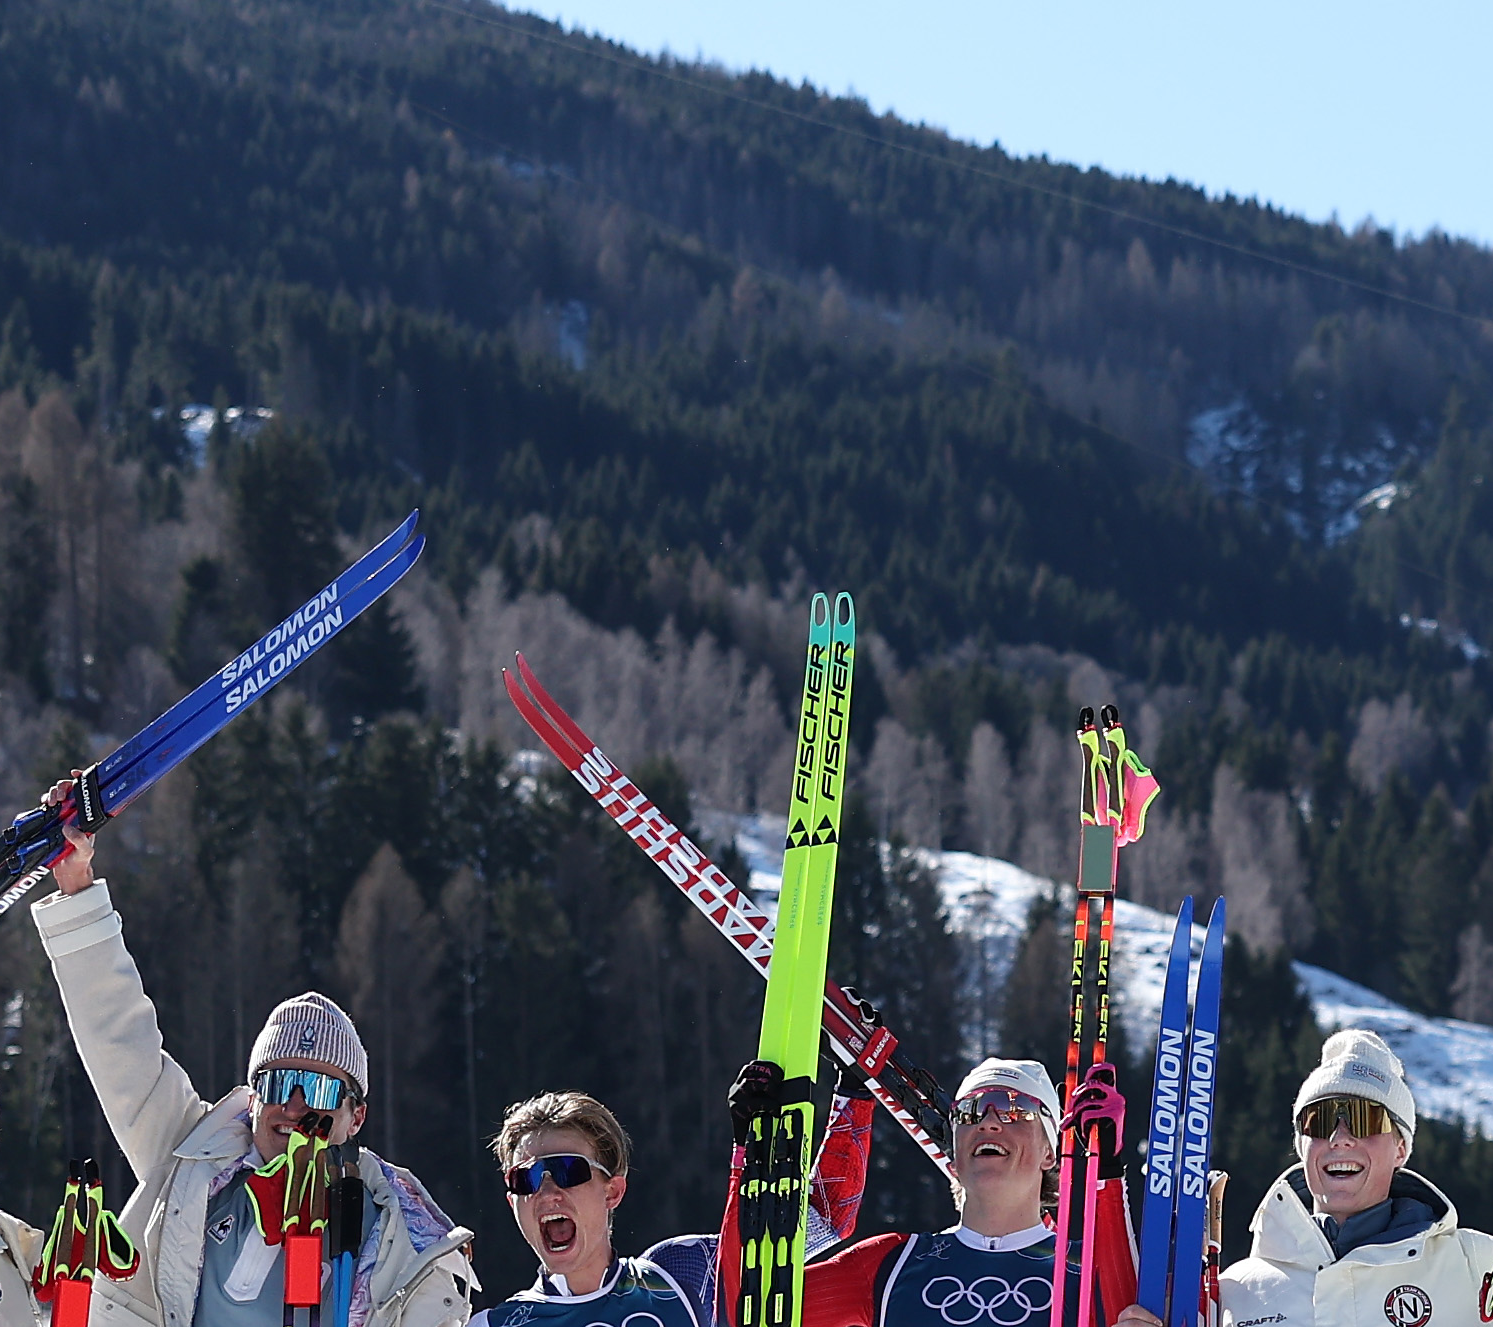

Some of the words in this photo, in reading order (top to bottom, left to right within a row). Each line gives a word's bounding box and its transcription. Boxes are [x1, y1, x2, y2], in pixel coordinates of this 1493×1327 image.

[221, 582, 340, 689] SALOMON
[225, 606, 344, 713] SALOMON
[795, 642, 826, 804] FISCHER
[821, 639, 850, 802] FISCHER
[1150, 1028, 1186, 1197] SALOMON
[1183, 1029, 1217, 1199] SALOMON
[1237, 1315, 1275, 1327] CRAFT
[1398, 1296, 1419, 1320] N
